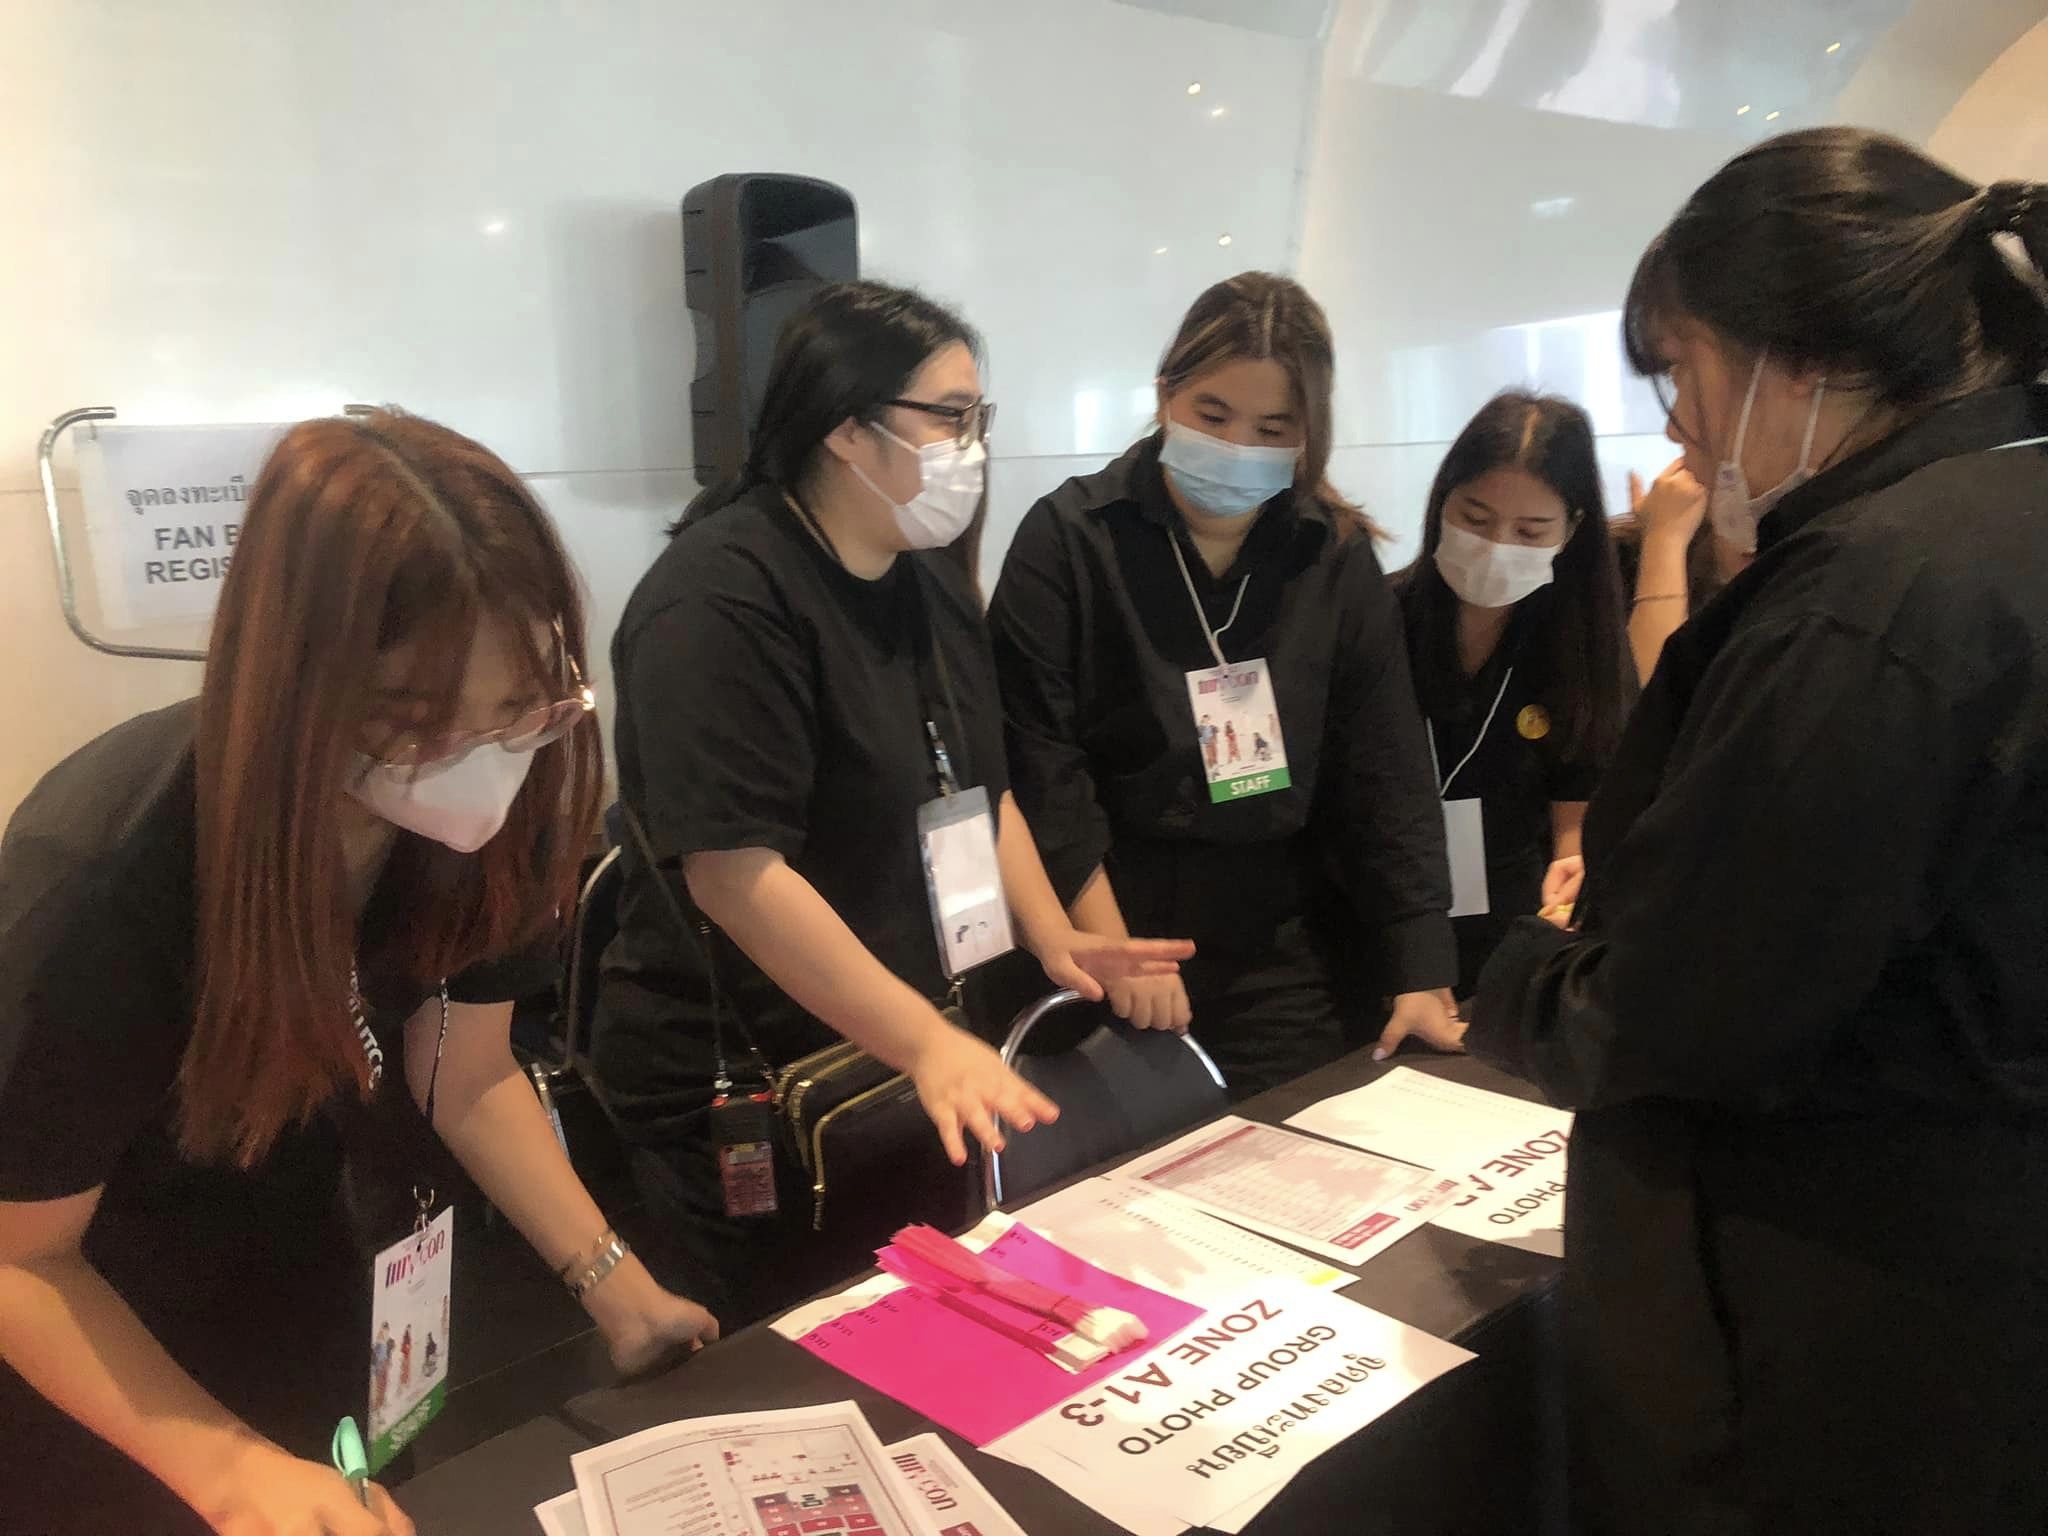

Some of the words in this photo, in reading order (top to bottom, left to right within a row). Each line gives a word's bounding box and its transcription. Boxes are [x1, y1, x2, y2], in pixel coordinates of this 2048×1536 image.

[154, 524, 216, 551] FAN
[1230, 775, 1272, 796] STAFF
[1479, 1129, 1569, 1178] ZONE
[1488, 1181, 1568, 1225] PHOTO
[1167, 1299, 1284, 1366] ZONE
[1237, 1325, 1336, 1391] GROUP
[1059, 1362, 1173, 1427] A1-3
[1118, 1388, 1236, 1455] PHOTO
[1185, 1352, 1386, 1479] จุดลงทะเบียน
